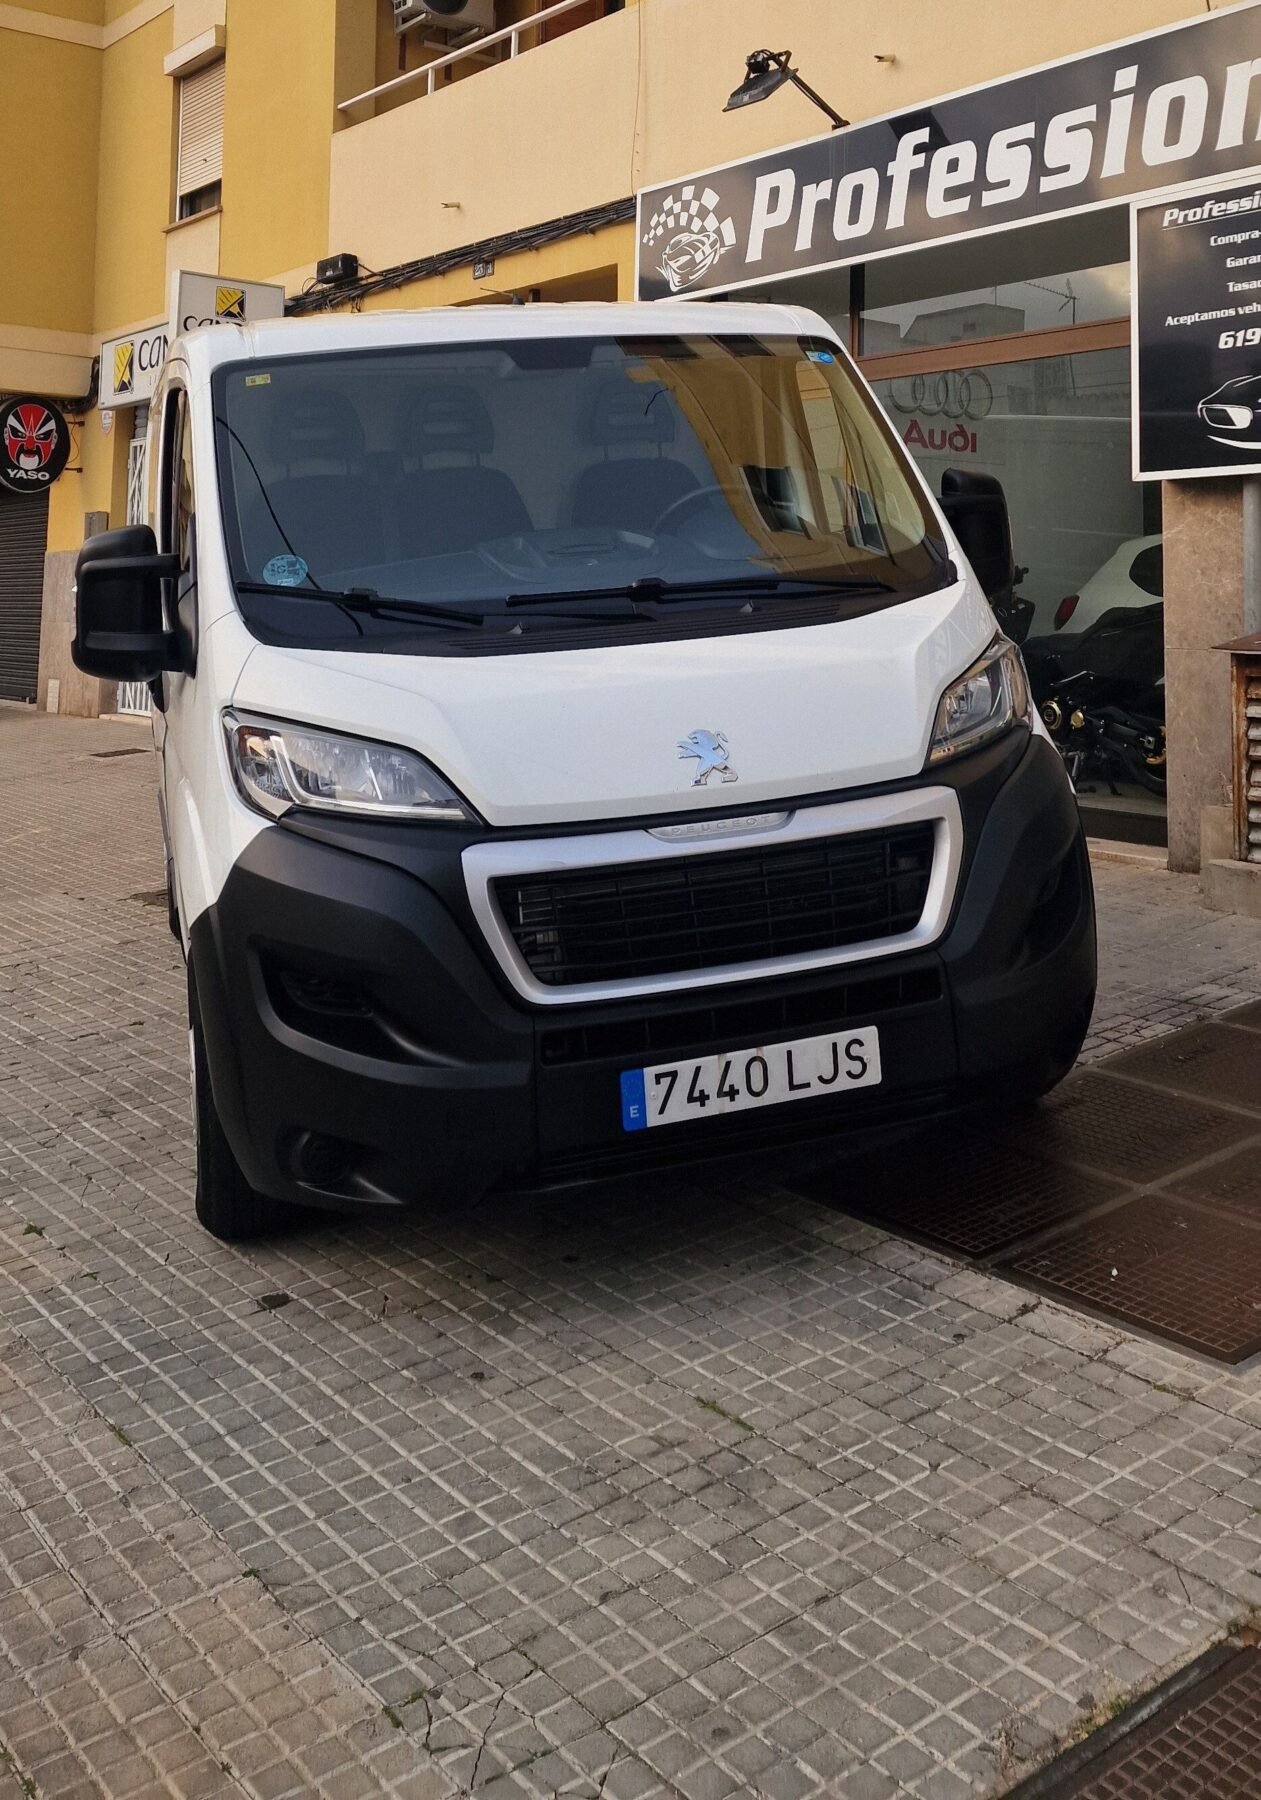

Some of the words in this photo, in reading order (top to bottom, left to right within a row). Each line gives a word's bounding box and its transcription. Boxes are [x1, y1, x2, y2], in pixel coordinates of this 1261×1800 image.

[745, 57, 1261, 263] Profession
[1165, 308, 1235, 327] Aceptamos
[1218, 327, 1261, 349] 619
[903, 419, 977, 453] Audi
[7, 468, 50, 480] YASO
[671, 815, 770, 836] PEUGEOT
[654, 1055, 768, 1115] 7440
[786, 1038, 868, 1092] LJS
[629, 1105, 639, 1118] E
